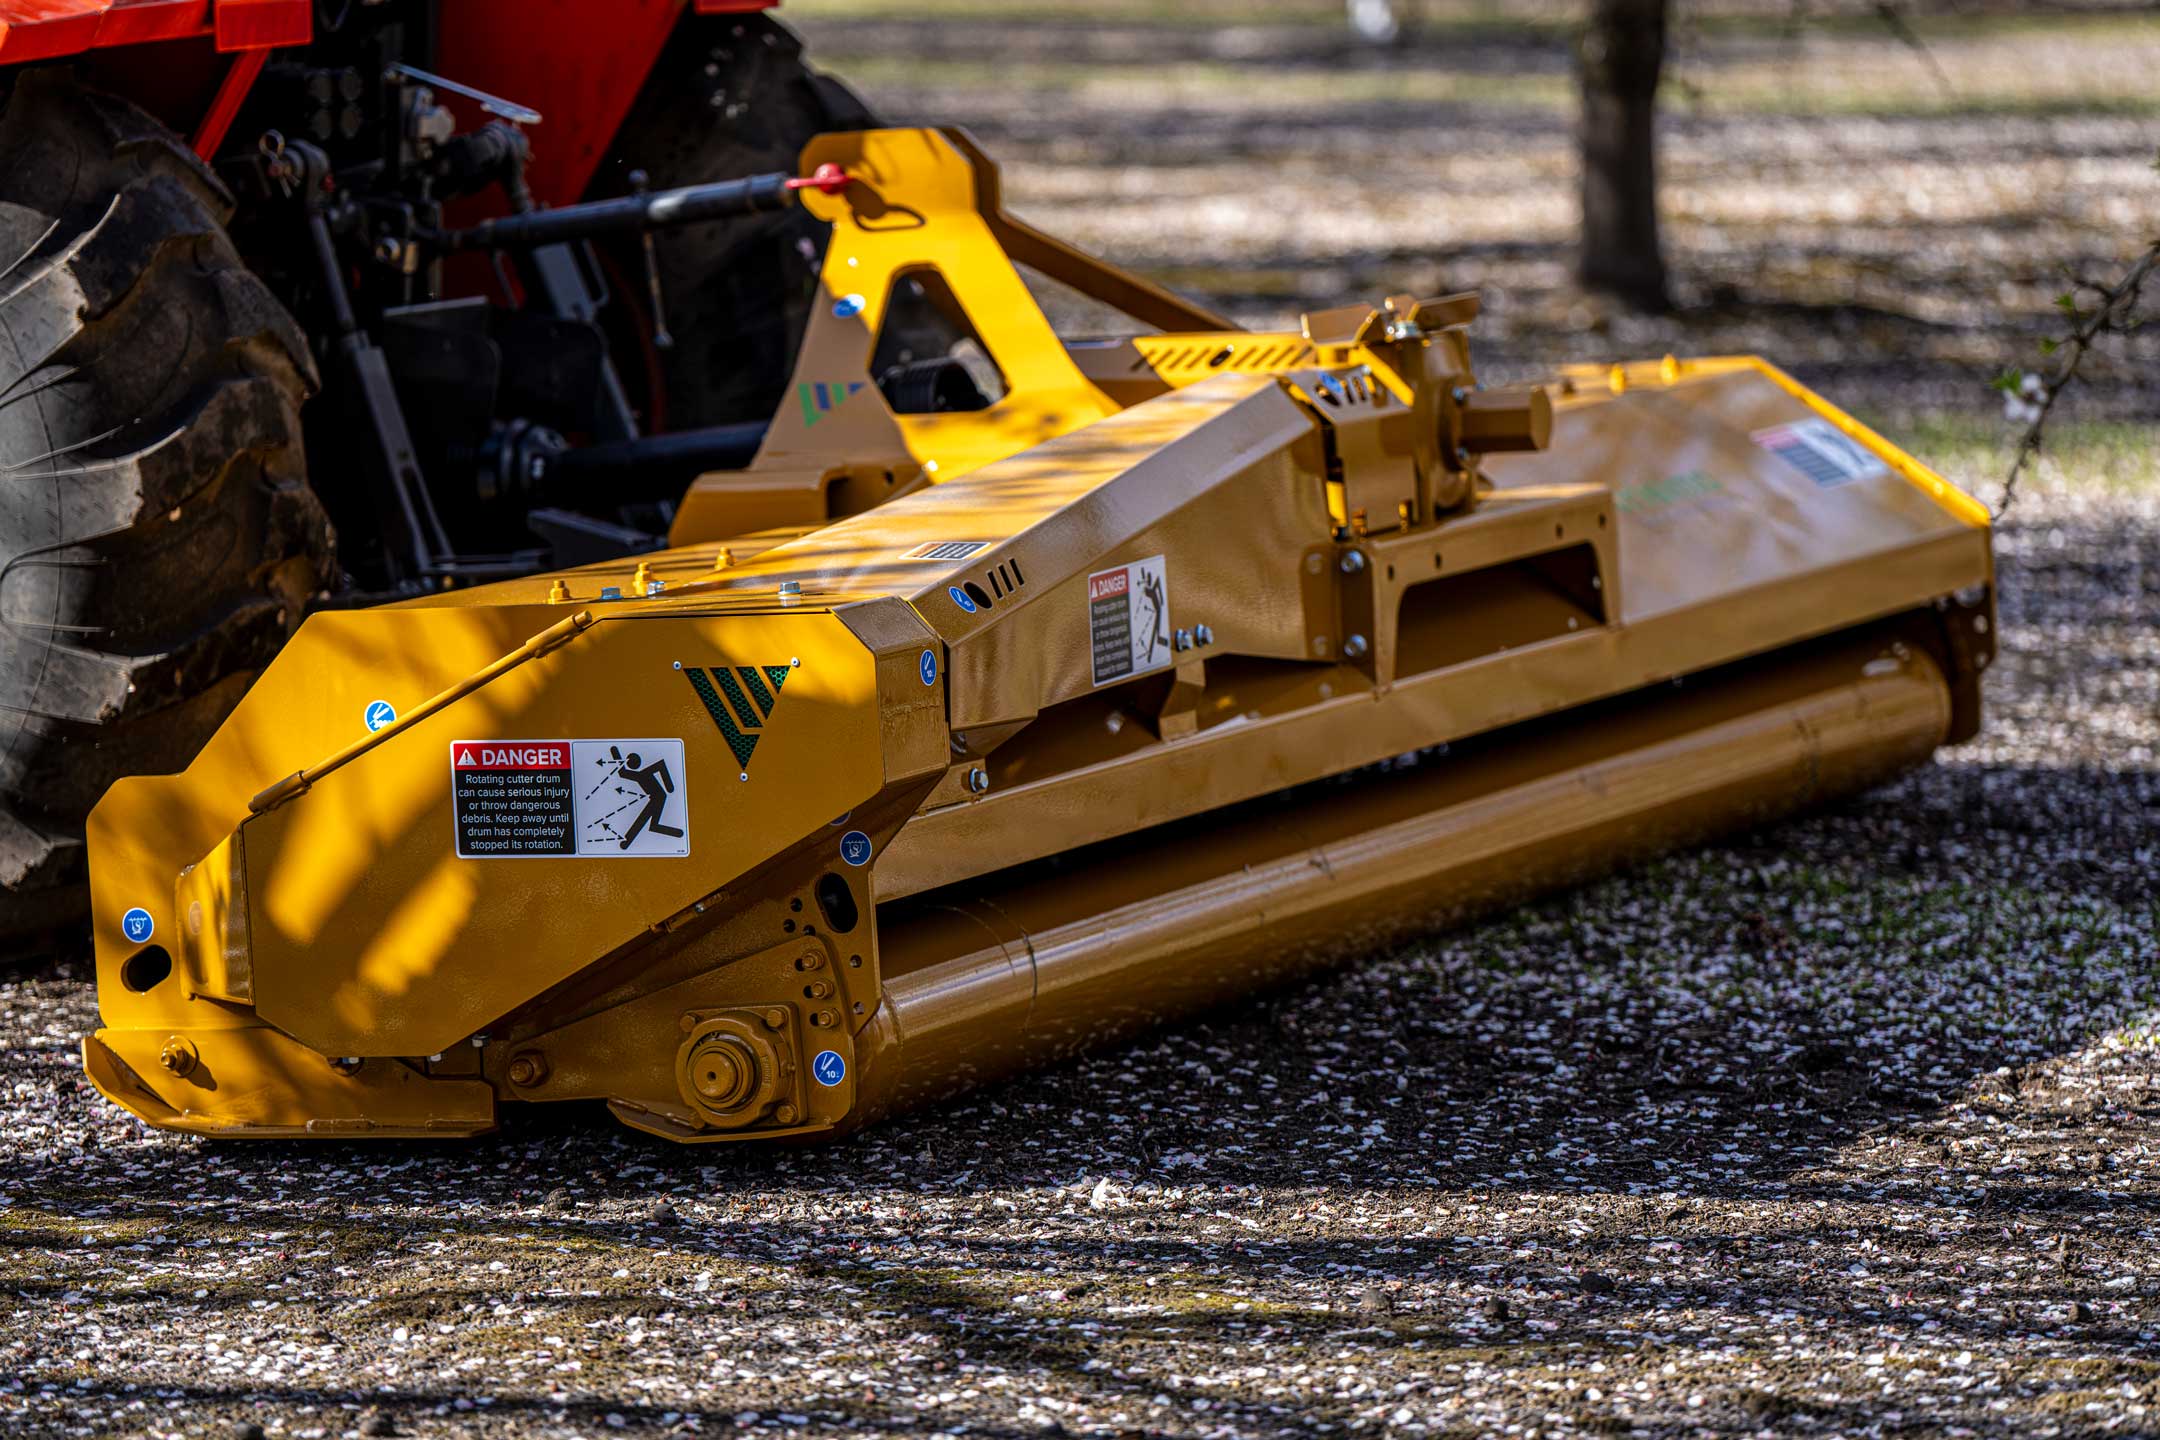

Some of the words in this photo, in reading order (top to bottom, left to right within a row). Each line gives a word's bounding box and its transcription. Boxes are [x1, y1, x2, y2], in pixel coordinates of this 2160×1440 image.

[1099, 574, 1126, 596] DANGER
[481, 748, 562, 766] DANGER
[465, 774, 504, 786] Rotating
[506, 774, 534, 784] cutter
[536, 774, 561, 783] drum
[458, 789, 475, 797] can
[477, 788, 506, 797] cause
[507, 787, 541, 797] serious
[544, 787, 570, 799] injury
[469, 802, 478, 810] or
[481, 801, 507, 810] throw
[510, 801, 561, 812] dangerous
[461, 814, 494, 823] debris.
[495, 814, 520, 825] Keep
[522, 815, 547, 825] away
[549, 813, 569, 823] until
[467, 827, 492, 837] drum
[494, 827, 511, 836] has
[513, 827, 565, 838] completely
[470, 840, 509, 851] stopped
[511, 840, 522, 849] its
[524, 840, 564, 849] rotation.
[826, 1070, 836, 1079] 10
